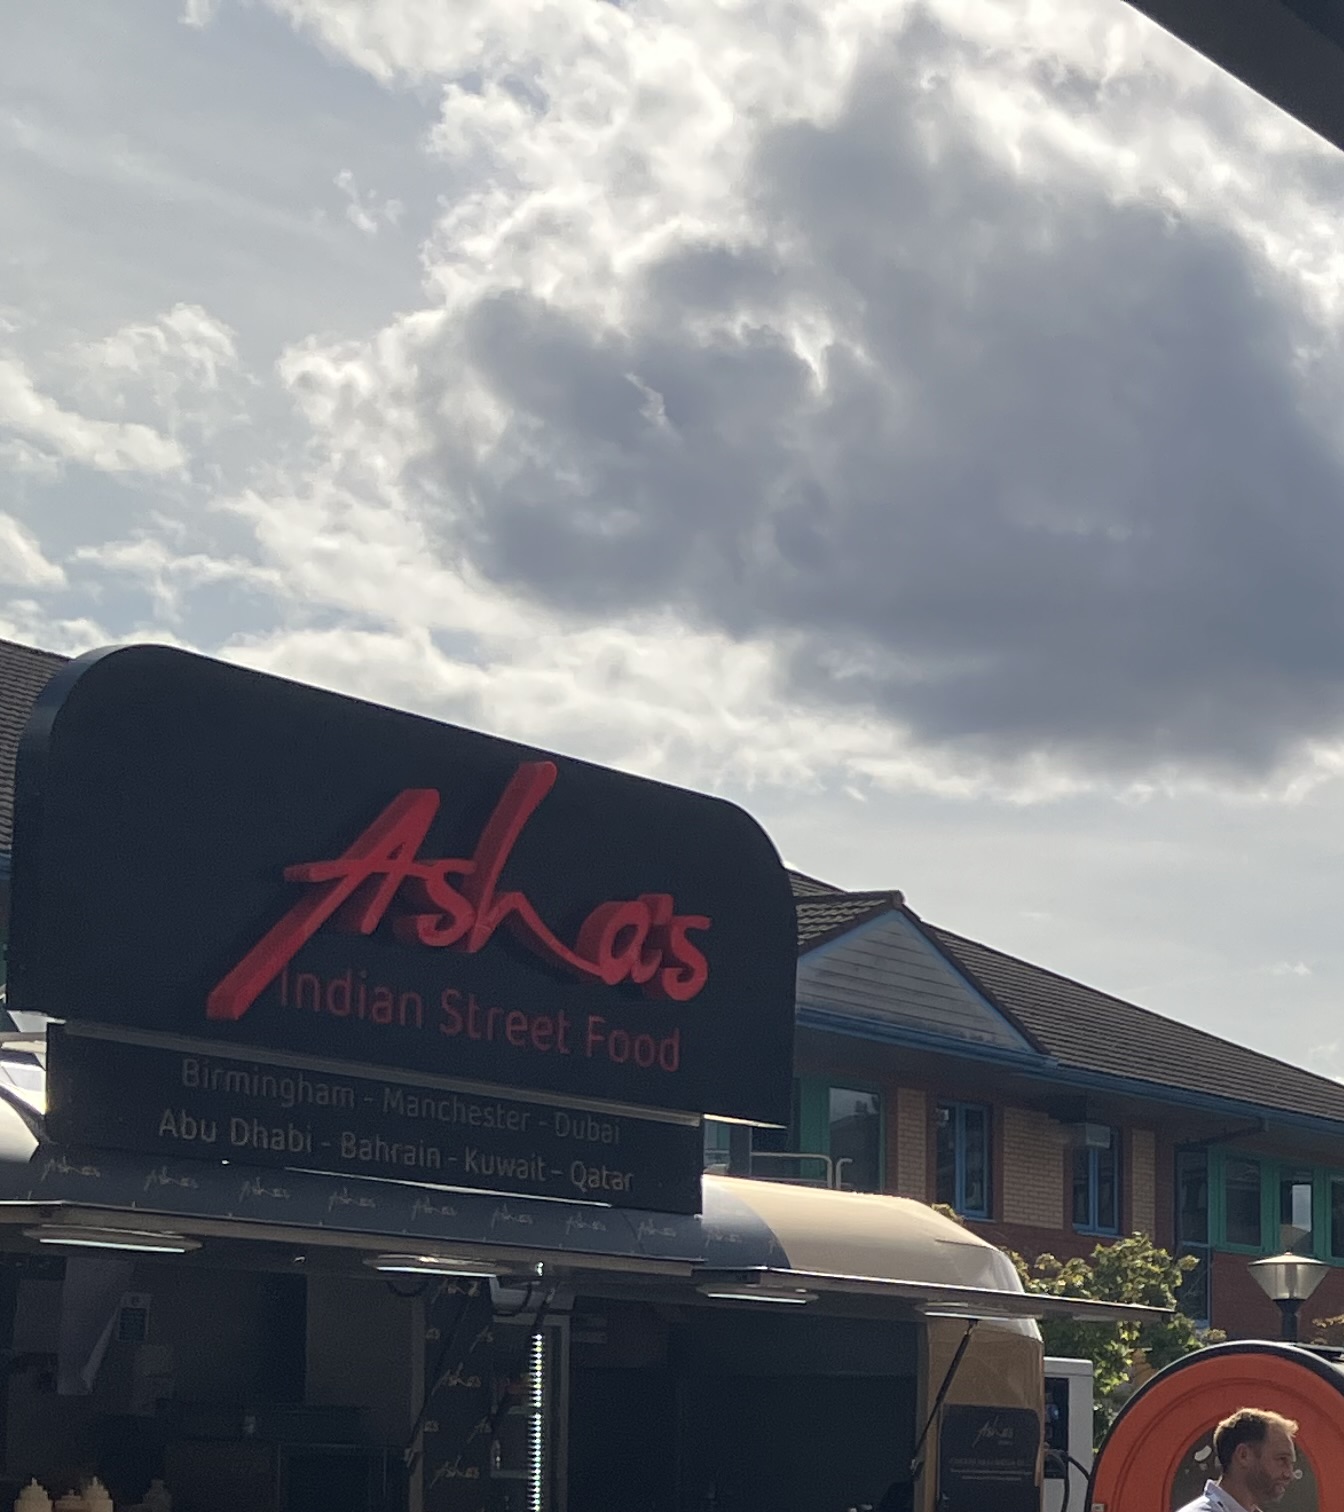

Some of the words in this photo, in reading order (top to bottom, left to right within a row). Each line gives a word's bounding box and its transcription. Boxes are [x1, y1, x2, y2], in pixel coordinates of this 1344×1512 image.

[206, 760, 711, 1020] Asha's
[280, 966, 425, 1030] Indian
[439, 990, 570, 1053] Street
[587, 1015, 680, 1072] Food
[183, 1059, 354, 1108] Birmingham
[384, 1088, 531, 1131] Manchester
[554, 1112, 621, 1145] Dubai
[159, 1109, 217, 1143] Abu
[231, 1118, 313, 1153] Dhabi
[341, 1132, 441, 1168] Bahrain
[465, 1149, 548, 1183] Kuwait
[569, 1160, 635, 1193] Qatar
